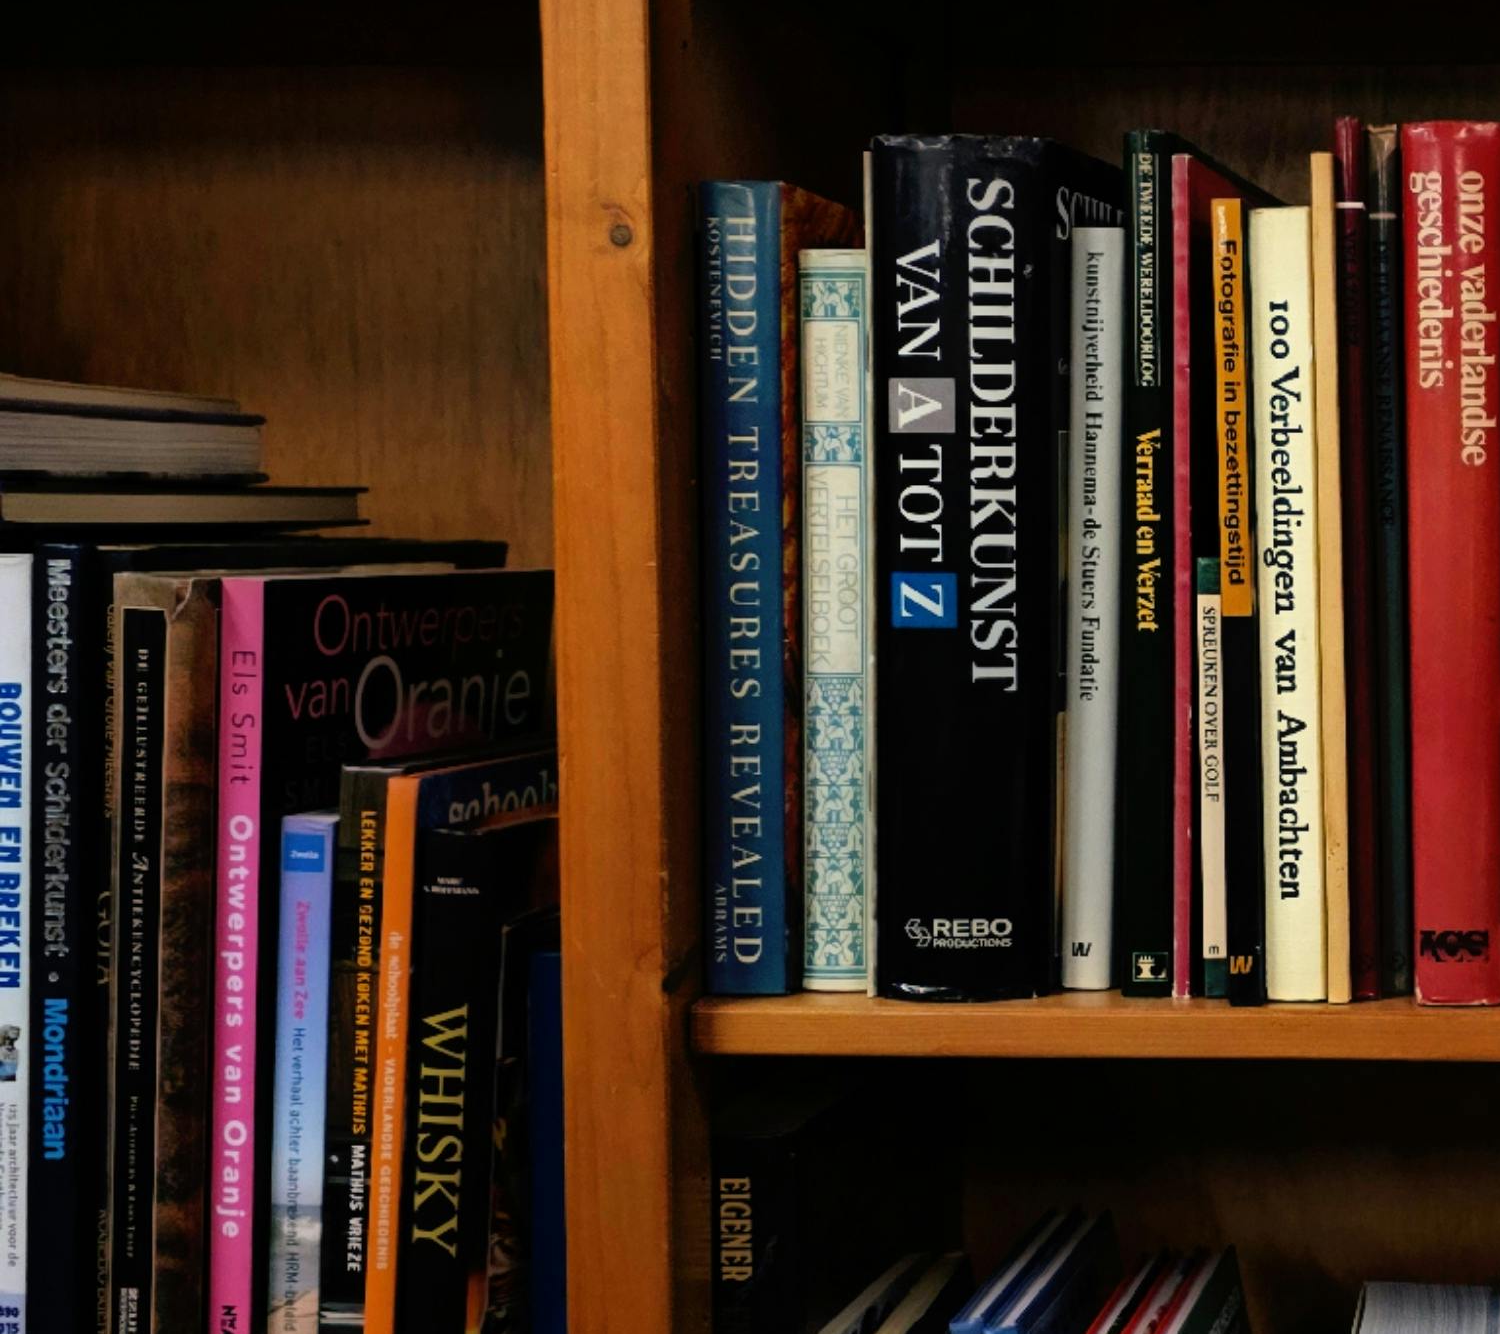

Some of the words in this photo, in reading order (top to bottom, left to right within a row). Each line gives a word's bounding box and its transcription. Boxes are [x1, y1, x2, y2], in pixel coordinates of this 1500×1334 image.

[1457, 170, 1488, 253] onze
[725, 217, 761, 406] HIDDEN
[896, 240, 942, 361] VAN
[1216, 239, 1242, 372] Fotografie
[1267, 300, 1289, 359] 100
[1409, 170, 1454, 389] geschiedenis
[898, 381, 943, 430] A
[1220, 380, 1242, 402] in
[1459, 263, 1497, 466] vaderlandse
[967, 177, 1018, 693] SCHILDERKUNST
[1134, 428, 1162, 522] Verraad
[1261, 365, 1305, 615] Verbeeldingen
[898, 443, 944, 564] TOT
[1136, 527, 1157, 555] en
[1222, 410, 1247, 586] bezettingstijd
[727, 424, 762, 700] TREASURES
[900, 580, 944, 619] Z
[1135, 559, 1162, 635] Verzet
[44, 558, 73, 693] Meesters
[230, 651, 258, 696] Els
[1202, 606, 1220, 698] SPREUKEN
[1275, 630, 1298, 694] van
[44, 703, 72, 749] der
[229, 711, 256, 786] Smit
[1205, 701, 1220, 751] OVER
[1205, 754, 1221, 803] GOLF
[43, 762, 72, 958] Schilderkunst
[728, 722, 763, 965] REVEALED
[1277, 709, 1309, 900] Ambachten
[220, 814, 254, 1027] Ontwerpers
[932, 917, 1014, 937] REBO
[42, 997, 70, 1161] Mondriaan
[221, 1045, 243, 1105] van
[411, 1002, 470, 1259] WHISKY
[215, 1118, 247, 1240] Oranje
